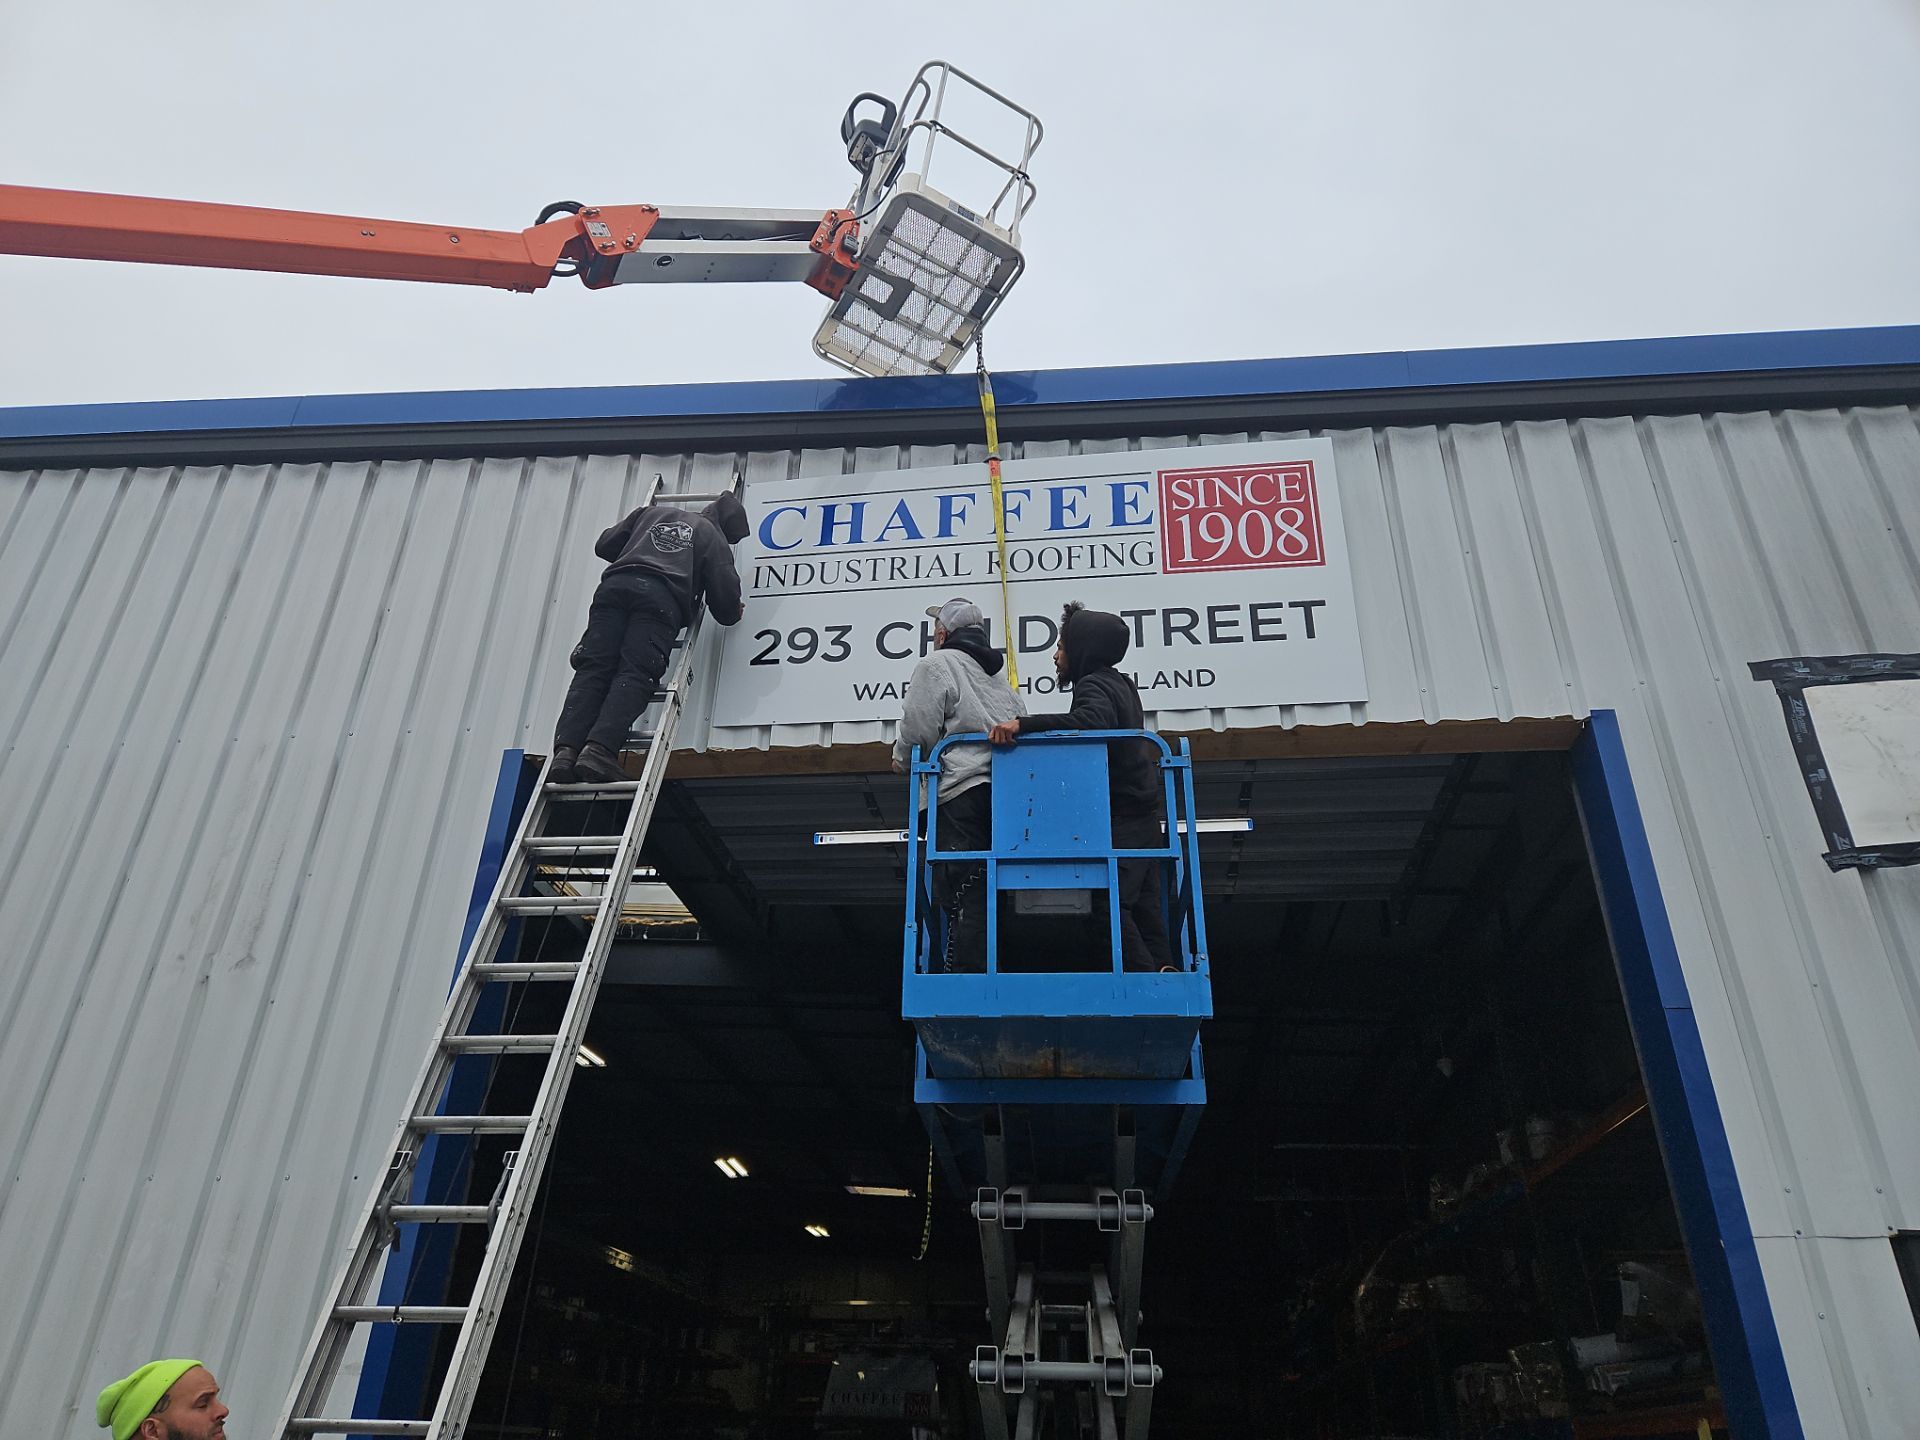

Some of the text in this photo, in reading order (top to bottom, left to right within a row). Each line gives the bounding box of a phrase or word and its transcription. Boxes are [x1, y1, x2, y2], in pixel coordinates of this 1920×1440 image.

[757, 480, 1154, 551] CHAFFEE
[1171, 472, 1306, 511] SINCE
[1173, 507, 1309, 563] 1908
[751, 540, 1155, 589] INDUSTRIAL ROOFING
[749, 599, 1326, 666] 293 CLD TREET
[1134, 668, 1216, 690] LAND
